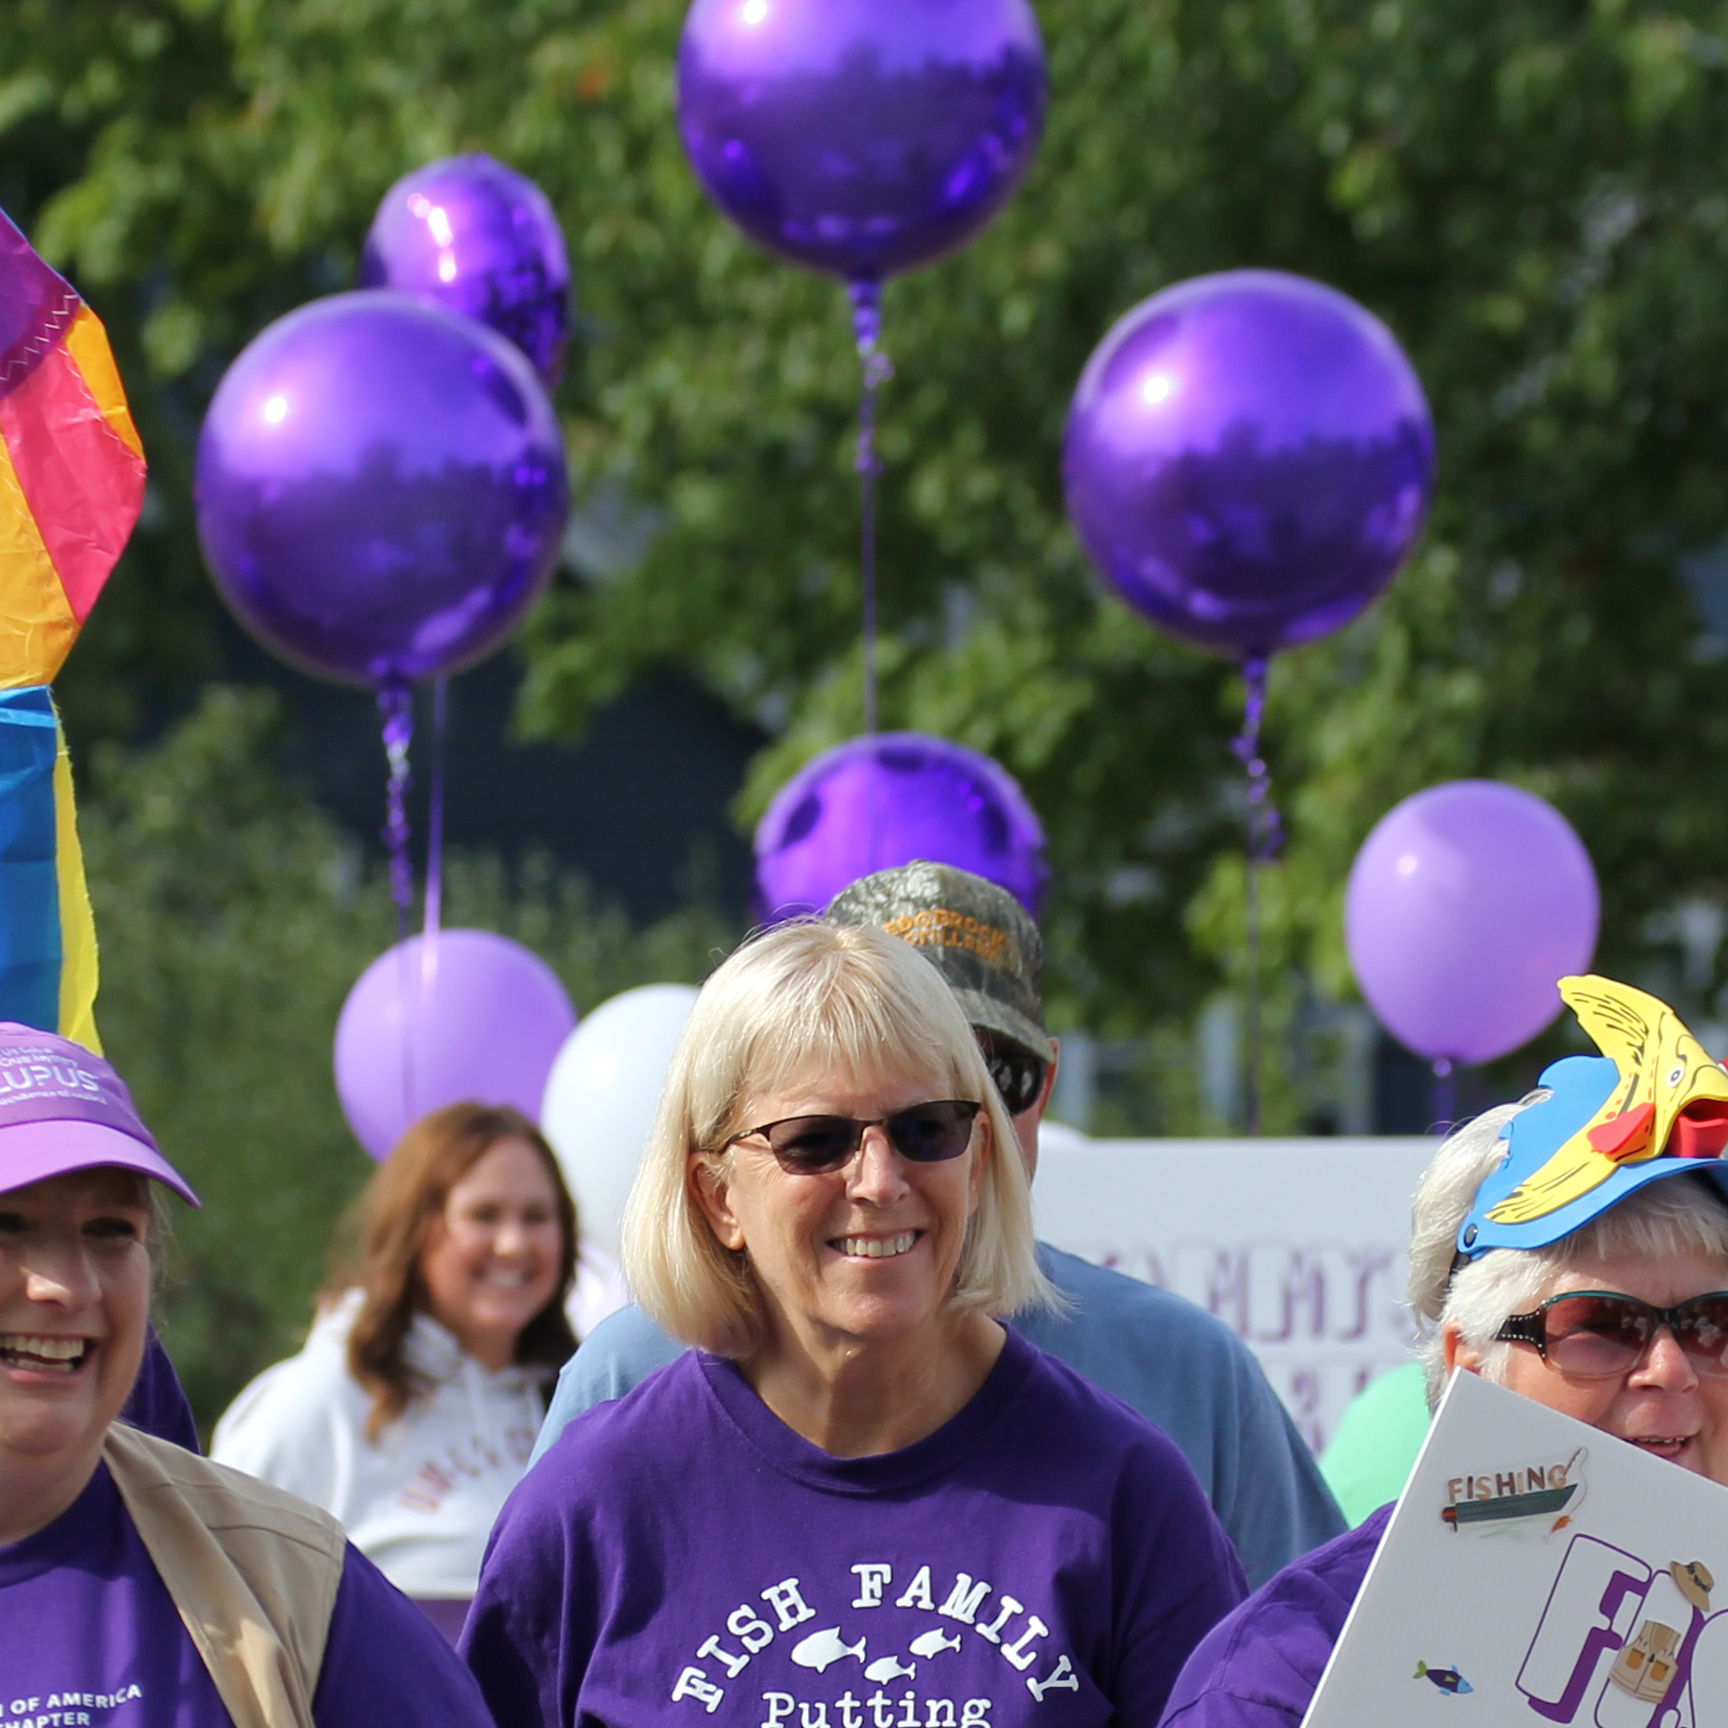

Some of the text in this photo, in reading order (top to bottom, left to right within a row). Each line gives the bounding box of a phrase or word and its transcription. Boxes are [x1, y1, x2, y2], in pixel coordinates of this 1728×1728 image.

[1447, 1464, 1568, 1504] FISHING
[672, 1563, 1080, 1714] FISH FAMILY
[9, 1697, 41, 1716] OF
[46, 1683, 143, 1710] AMERICA
